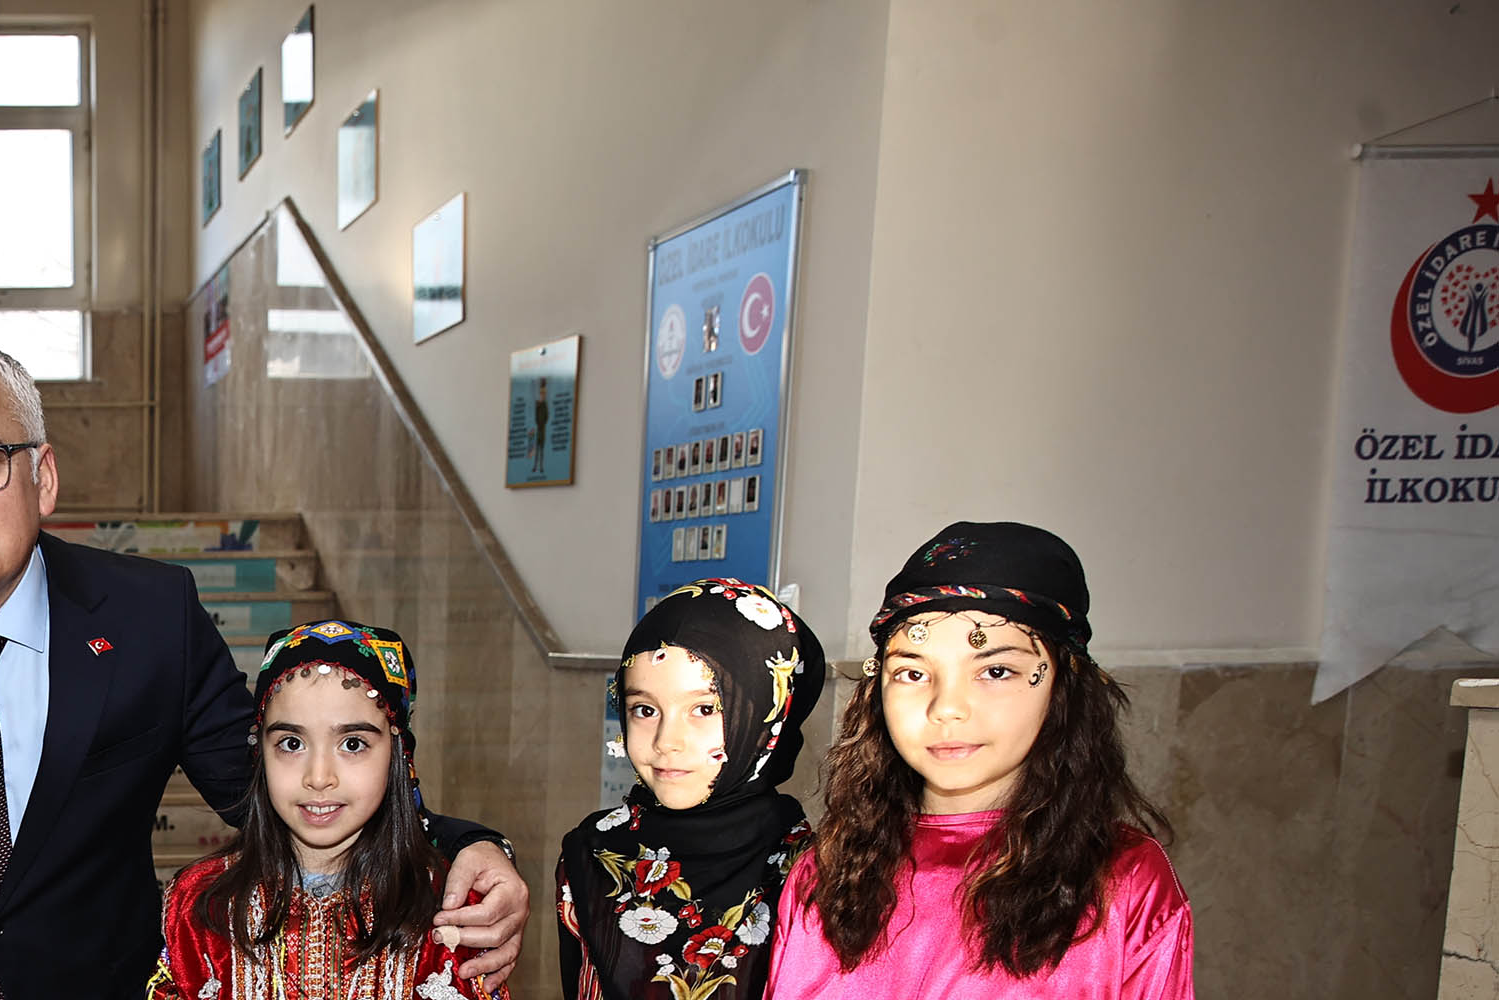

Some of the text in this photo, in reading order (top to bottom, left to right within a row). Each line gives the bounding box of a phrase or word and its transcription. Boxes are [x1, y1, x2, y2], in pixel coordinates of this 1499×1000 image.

[1415, 230, 1487, 348] ÖZEL İDARE
[1355, 427, 1444, 460] ÖZEL
[1364, 467, 1499, 503] İLKOKU
